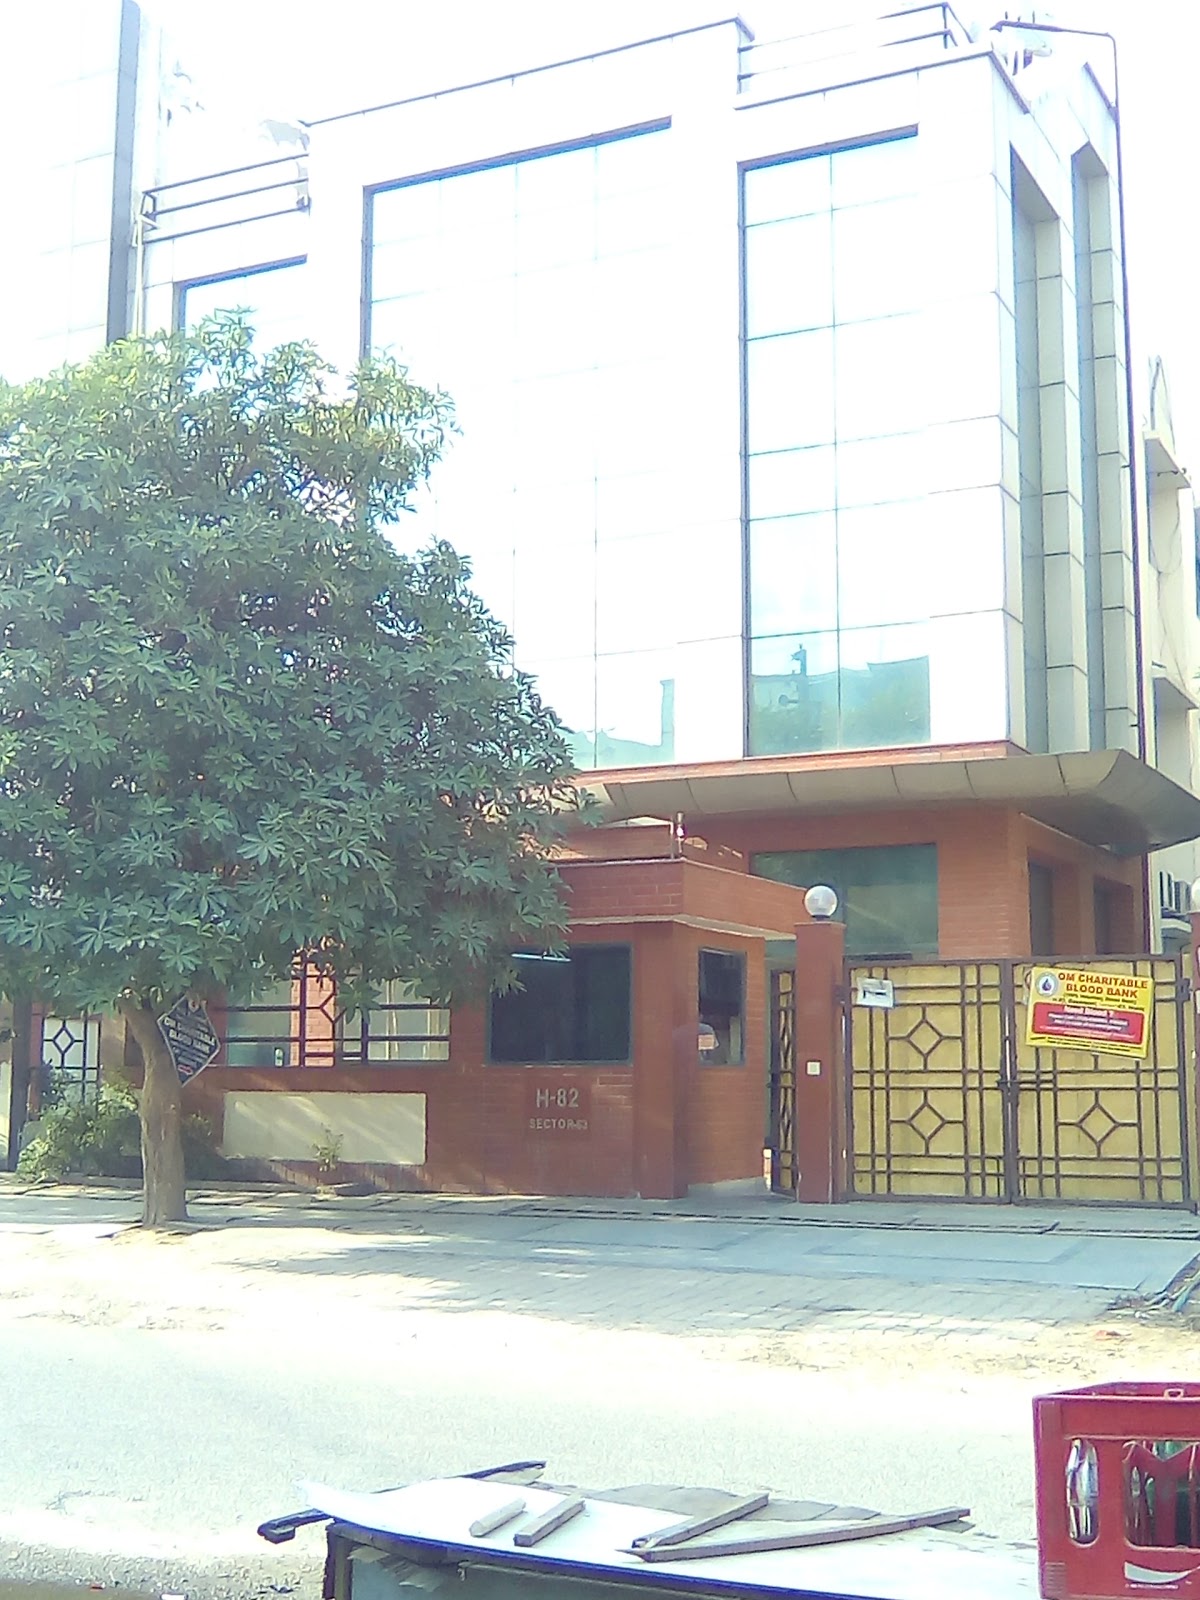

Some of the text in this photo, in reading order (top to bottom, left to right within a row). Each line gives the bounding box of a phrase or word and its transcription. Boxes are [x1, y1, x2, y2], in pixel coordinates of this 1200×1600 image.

[1058, 972, 1148, 989] OM CHARITABLE
[1066, 983, 1138, 998] BLOOD BANK
[536, 1087, 579, 1108] H-82
